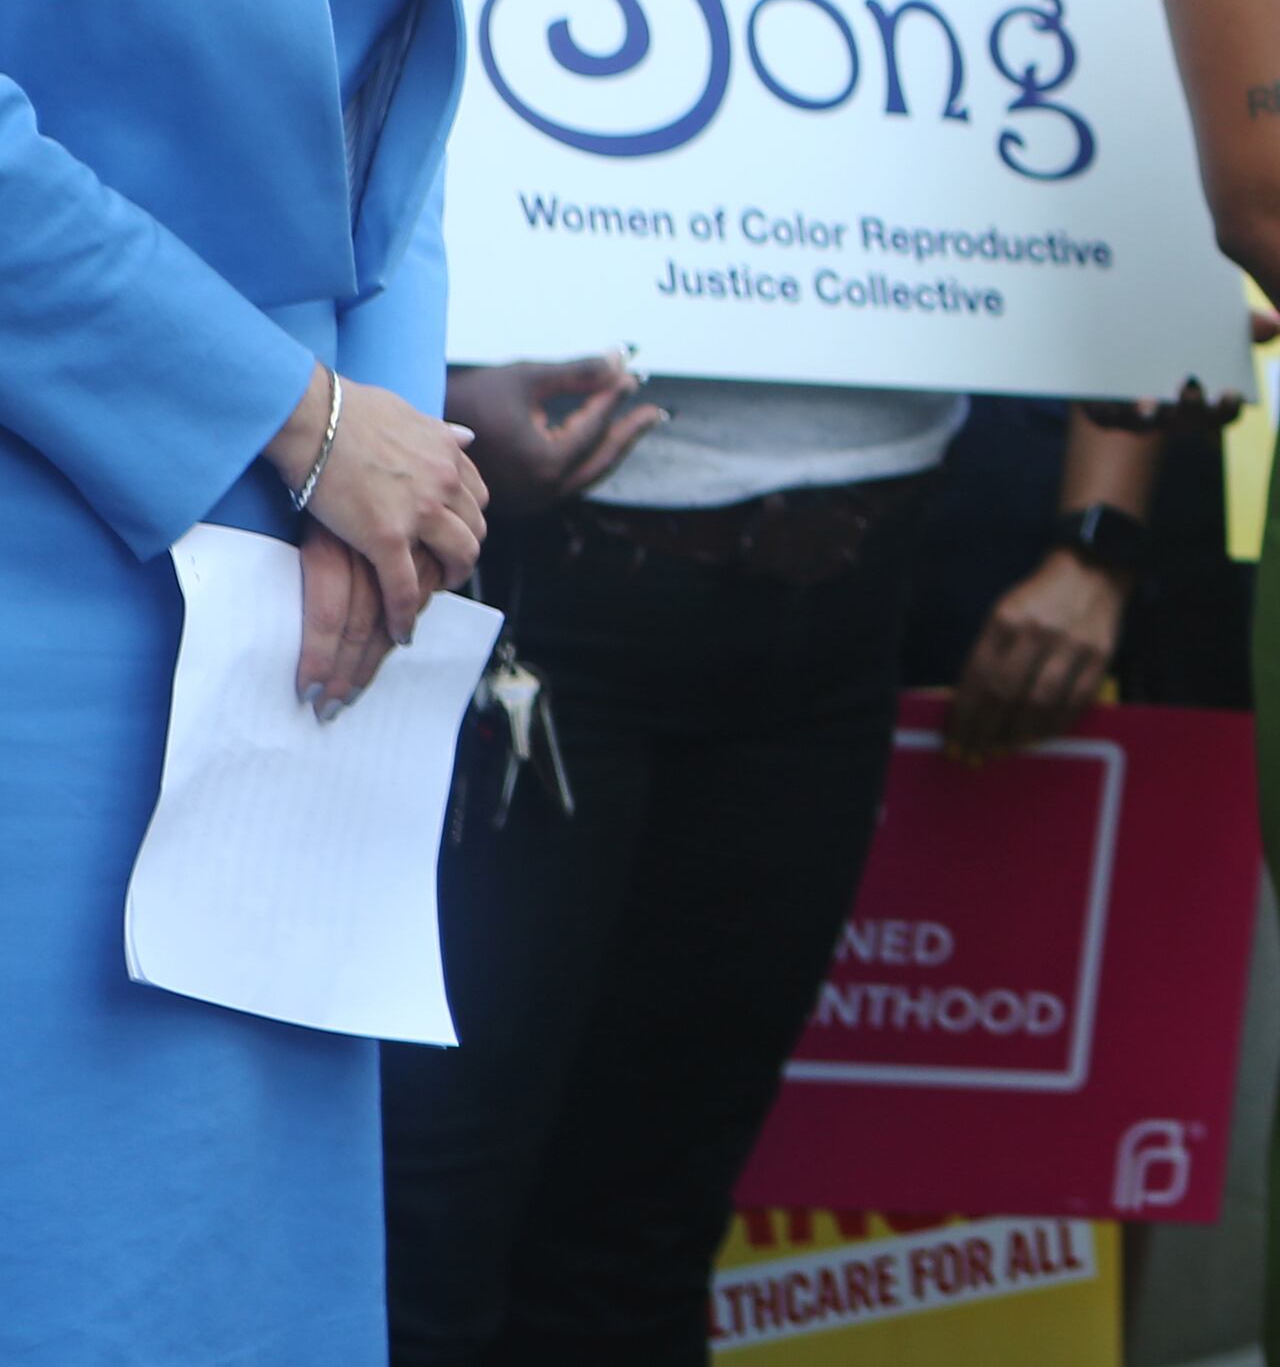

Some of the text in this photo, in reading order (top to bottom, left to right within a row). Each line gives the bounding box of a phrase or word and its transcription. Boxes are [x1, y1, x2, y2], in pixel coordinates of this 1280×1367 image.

[519, 190, 1115, 270] Women of Color Reproductive
[656, 260, 1006, 318] Justice Collective
[835, 920, 955, 967] NED
[817, 982, 1067, 1036] NTHOOD
[706, 1254, 900, 1340] LTHCARE
[908, 1236, 997, 1302] FOR
[1004, 1217, 1083, 1283] ALL
